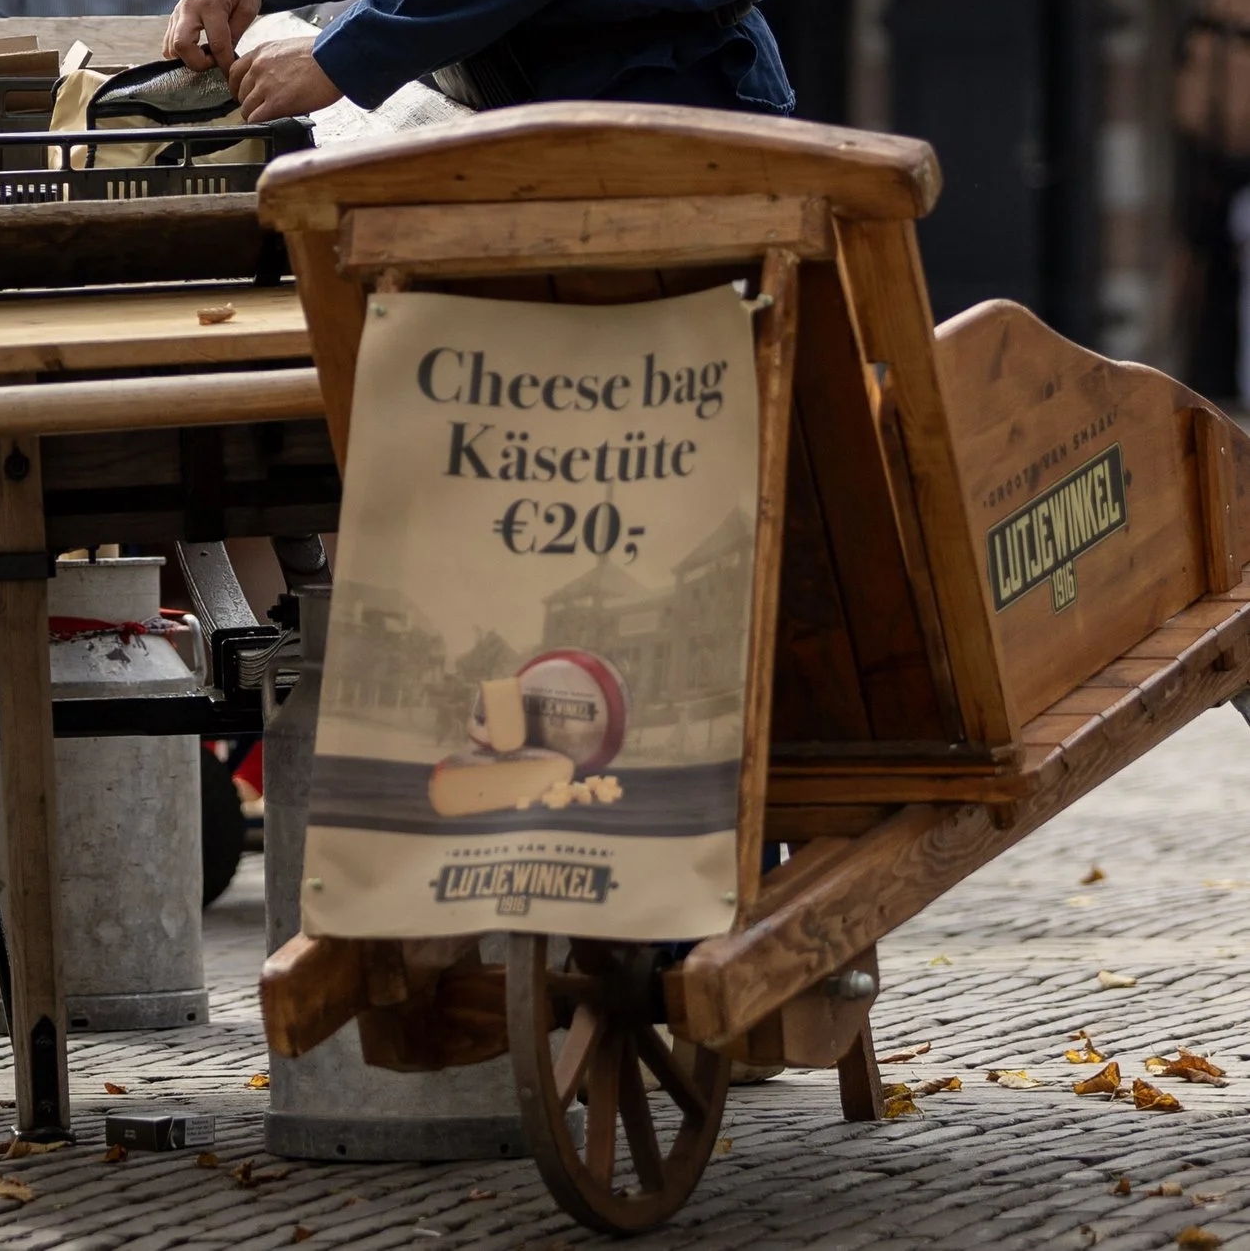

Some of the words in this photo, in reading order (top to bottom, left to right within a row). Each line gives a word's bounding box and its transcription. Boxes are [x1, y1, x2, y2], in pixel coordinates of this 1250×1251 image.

[416, 346, 632, 412] Cheese
[641, 352, 728, 420] bag
[442, 419, 697, 484] Käsetüte
[993, 458, 1121, 601] LUTJEWINKEL
[1052, 560, 1076, 608] 1916
[444, 862, 597, 899] LUTJEWINKEL
